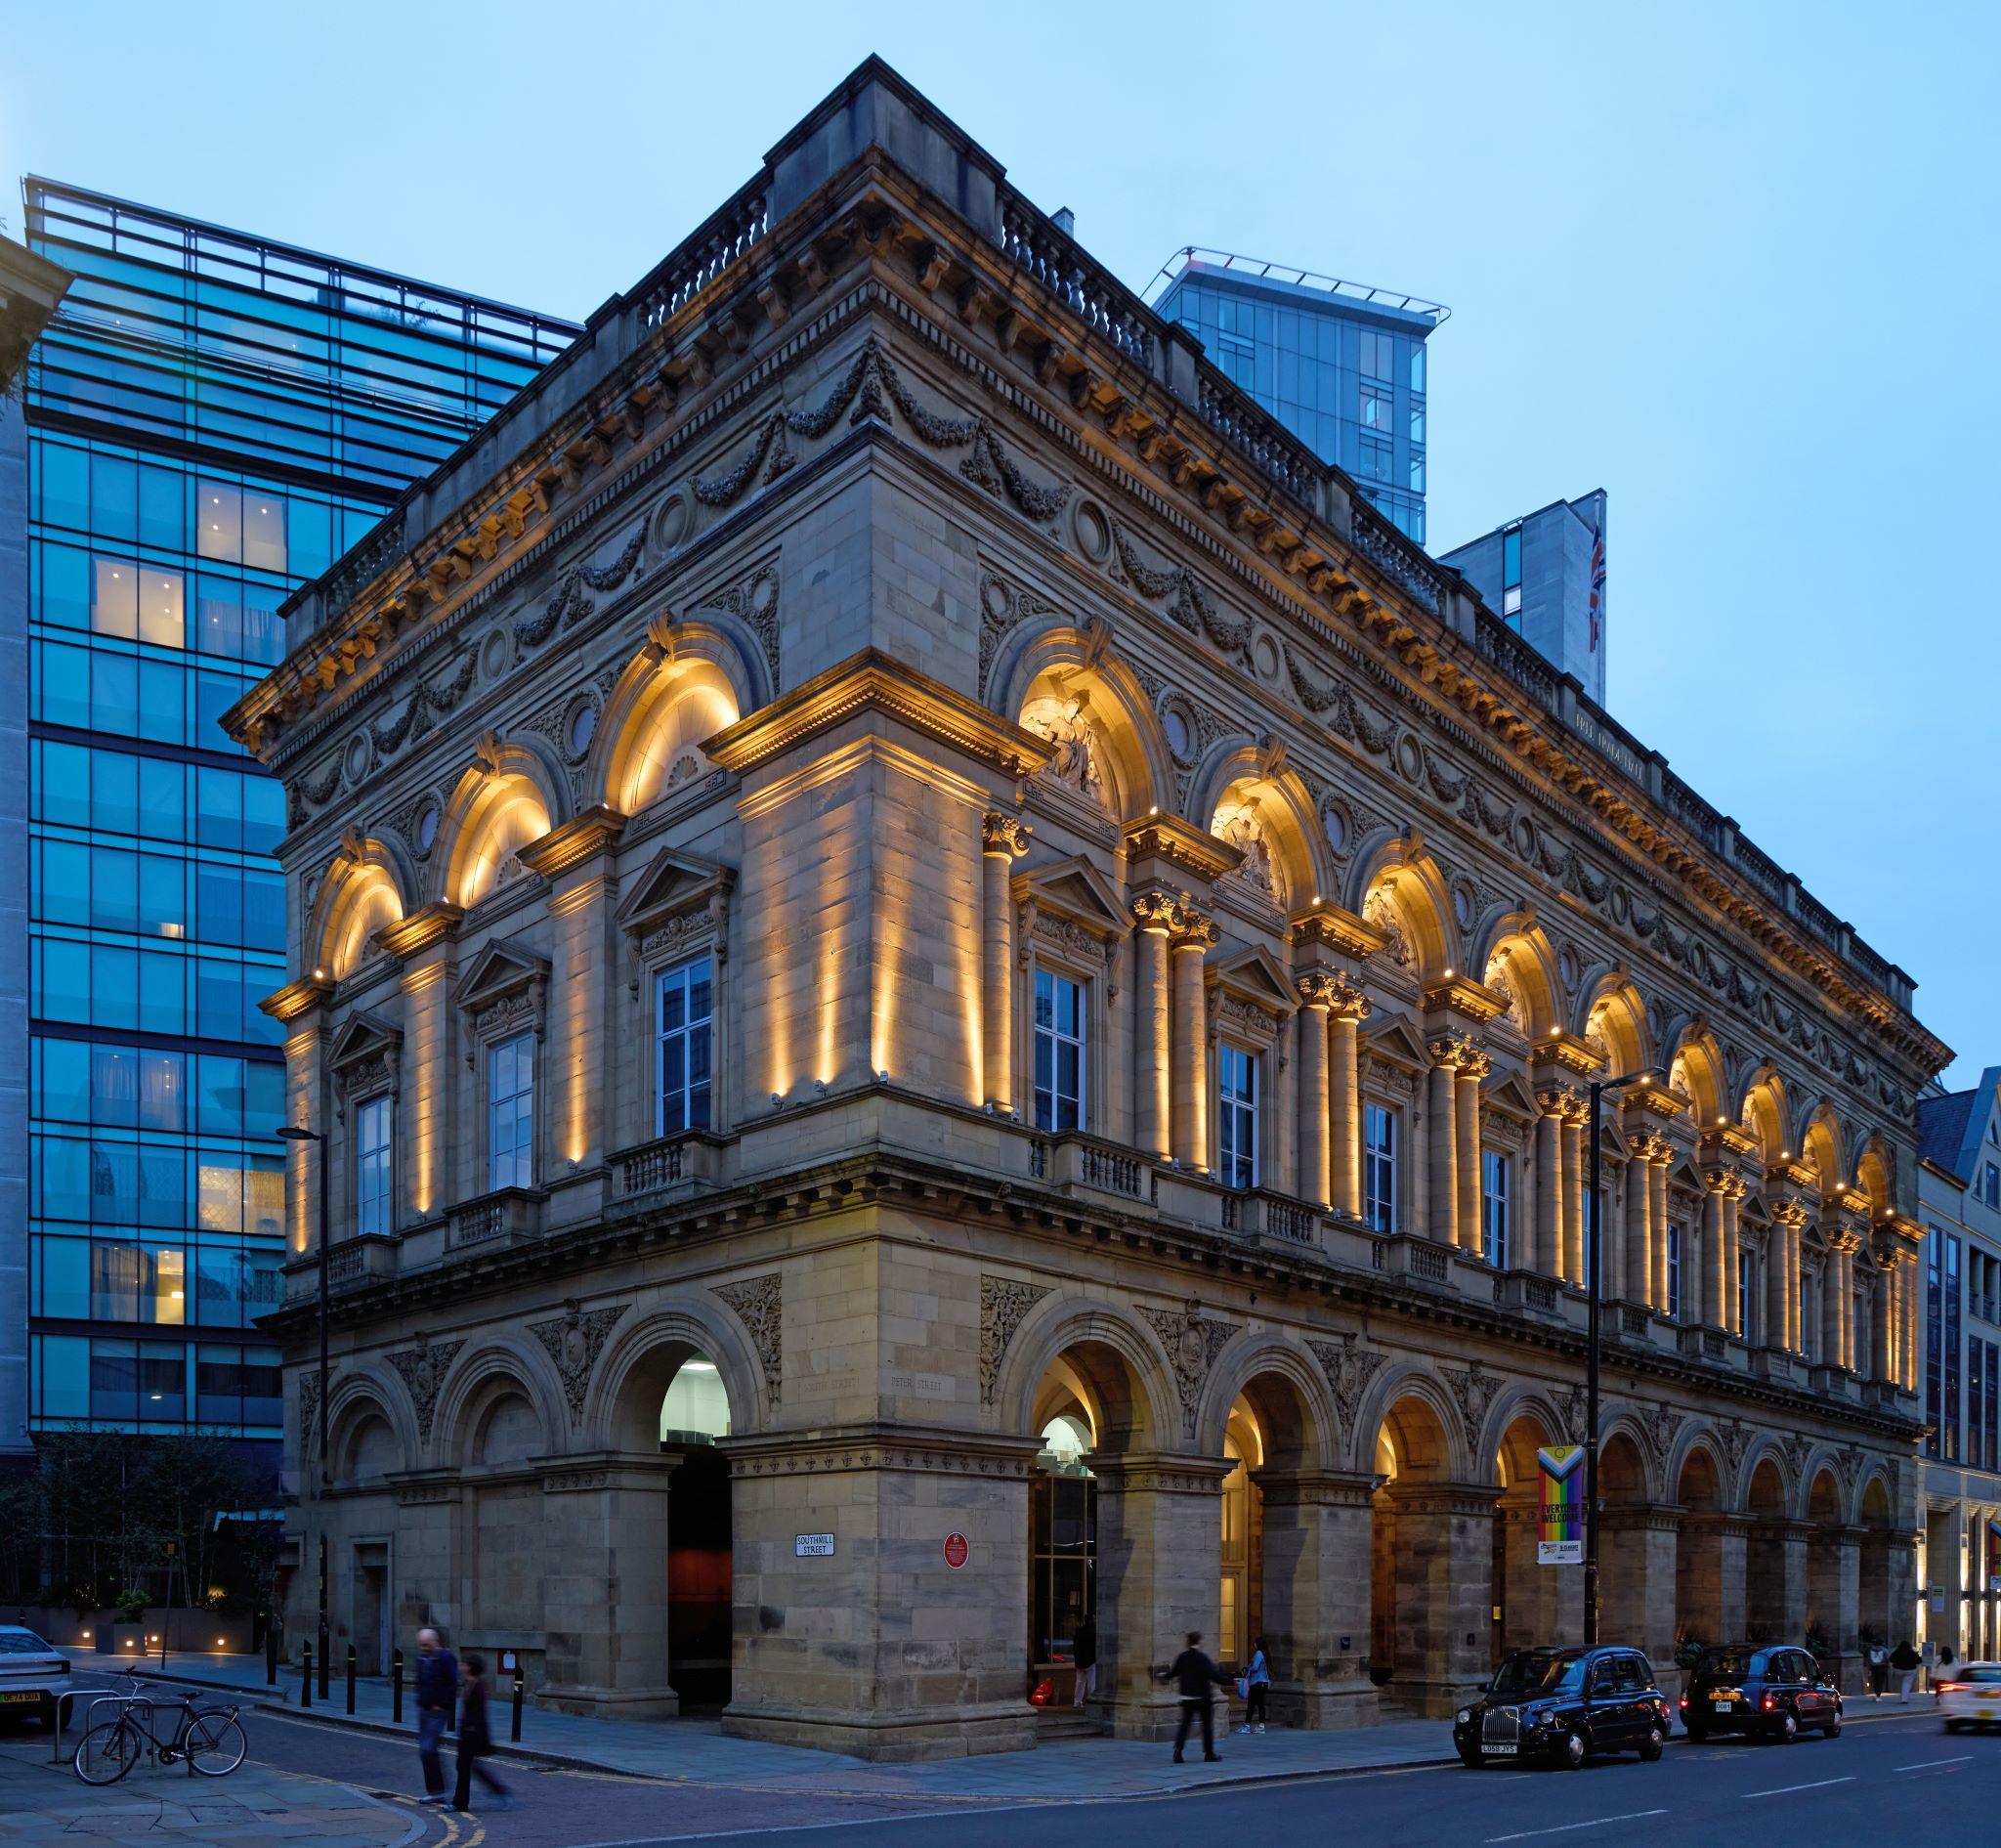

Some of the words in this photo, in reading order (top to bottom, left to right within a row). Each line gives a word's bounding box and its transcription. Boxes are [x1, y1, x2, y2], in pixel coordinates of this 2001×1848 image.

[891, 1376, 912, 1390] PETER
[916, 1379, 942, 1393] STREET
[1542, 1503, 1580, 1514] EVERYONE
[1542, 1514, 1579, 1524] WELCOME
[797, 1535, 832, 1544] SOUTHMILL
[803, 1545, 826, 1554] STREET
